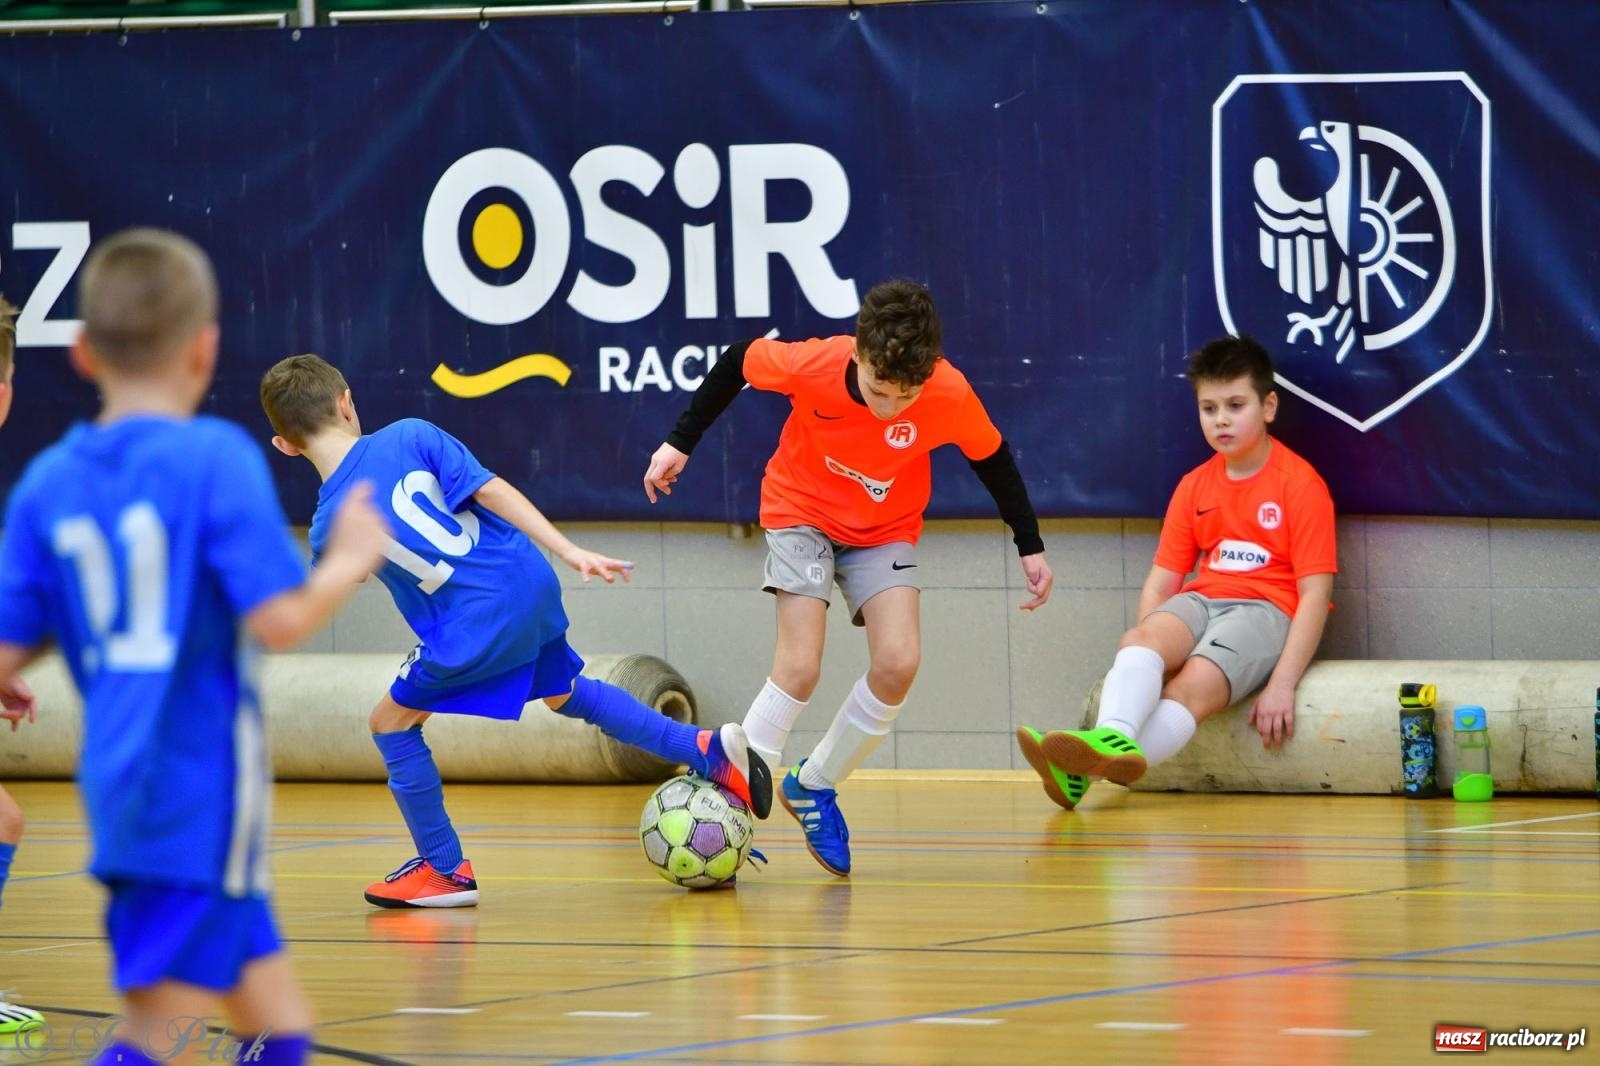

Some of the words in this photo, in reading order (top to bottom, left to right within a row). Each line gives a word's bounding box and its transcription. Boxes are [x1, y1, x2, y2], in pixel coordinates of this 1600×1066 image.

[0, 221, 91, 348] Z
[54, 501, 177, 673] 11
[376, 470, 480, 595] 10
[1221, 549, 1266, 564] PAKON
